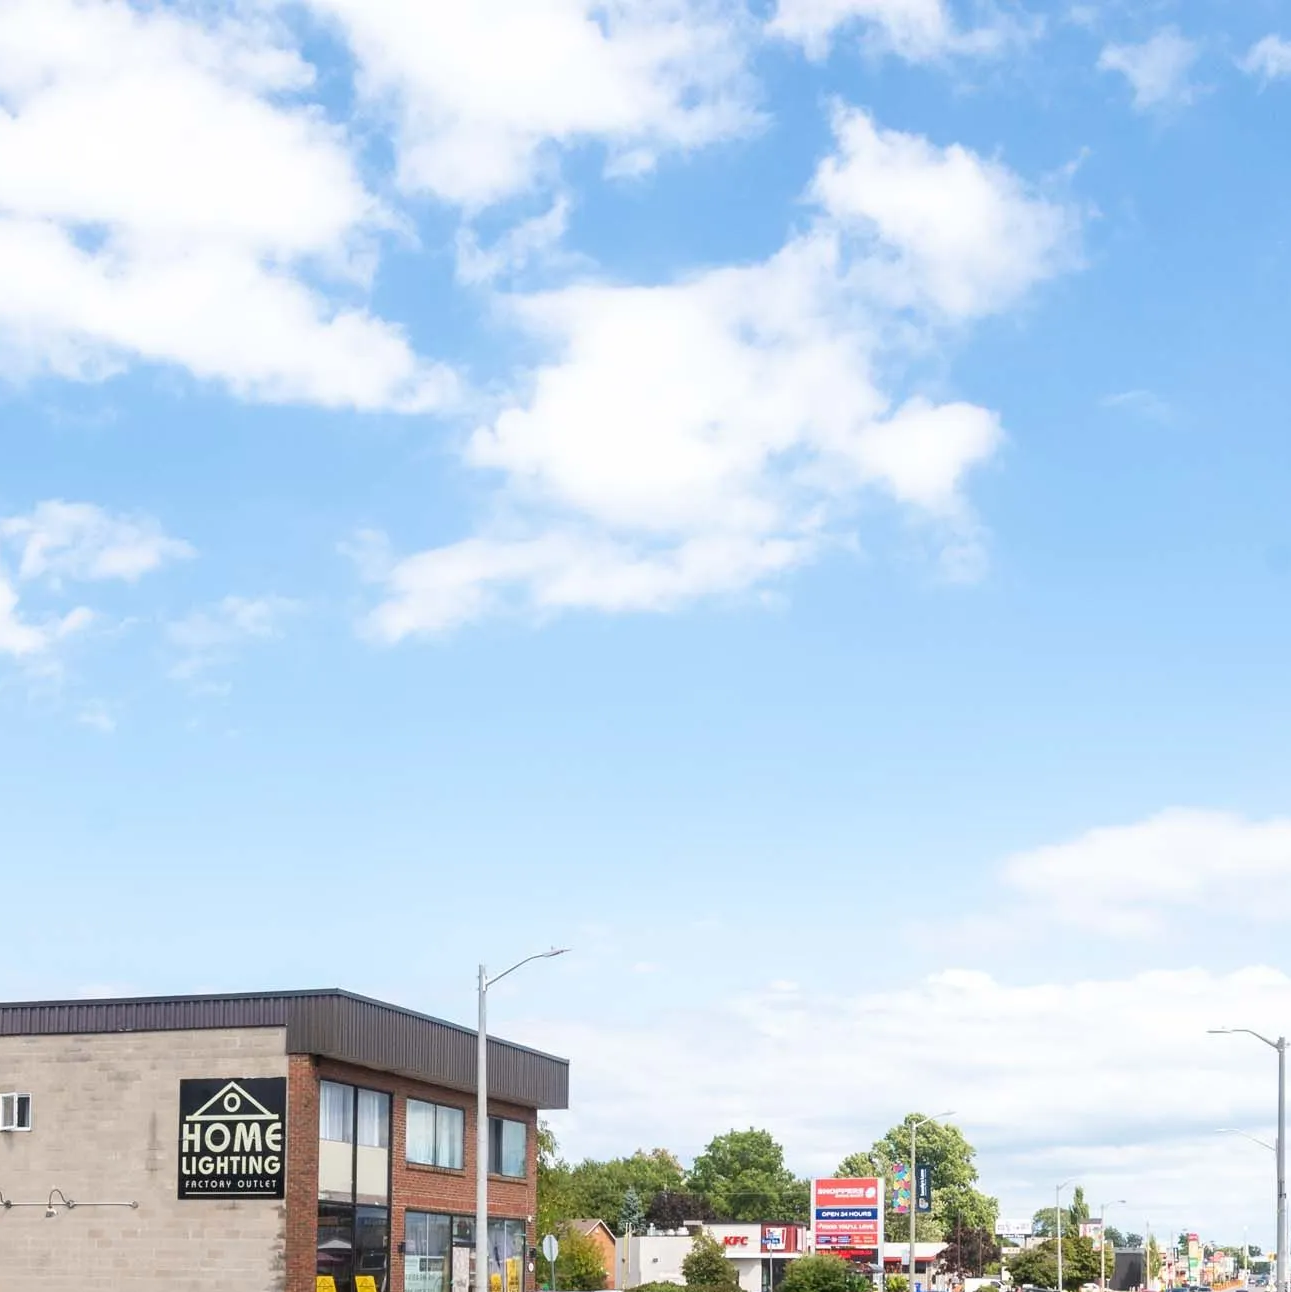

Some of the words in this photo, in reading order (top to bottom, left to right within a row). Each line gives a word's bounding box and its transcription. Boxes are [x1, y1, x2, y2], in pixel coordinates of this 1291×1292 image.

[182, 1122, 282, 1153] HOME
[182, 1155, 281, 1175] LIGHTING
[185, 1180, 232, 1188] FACTORY
[237, 1179, 277, 1188] OUTLET
[724, 1236, 749, 1246] KFC
